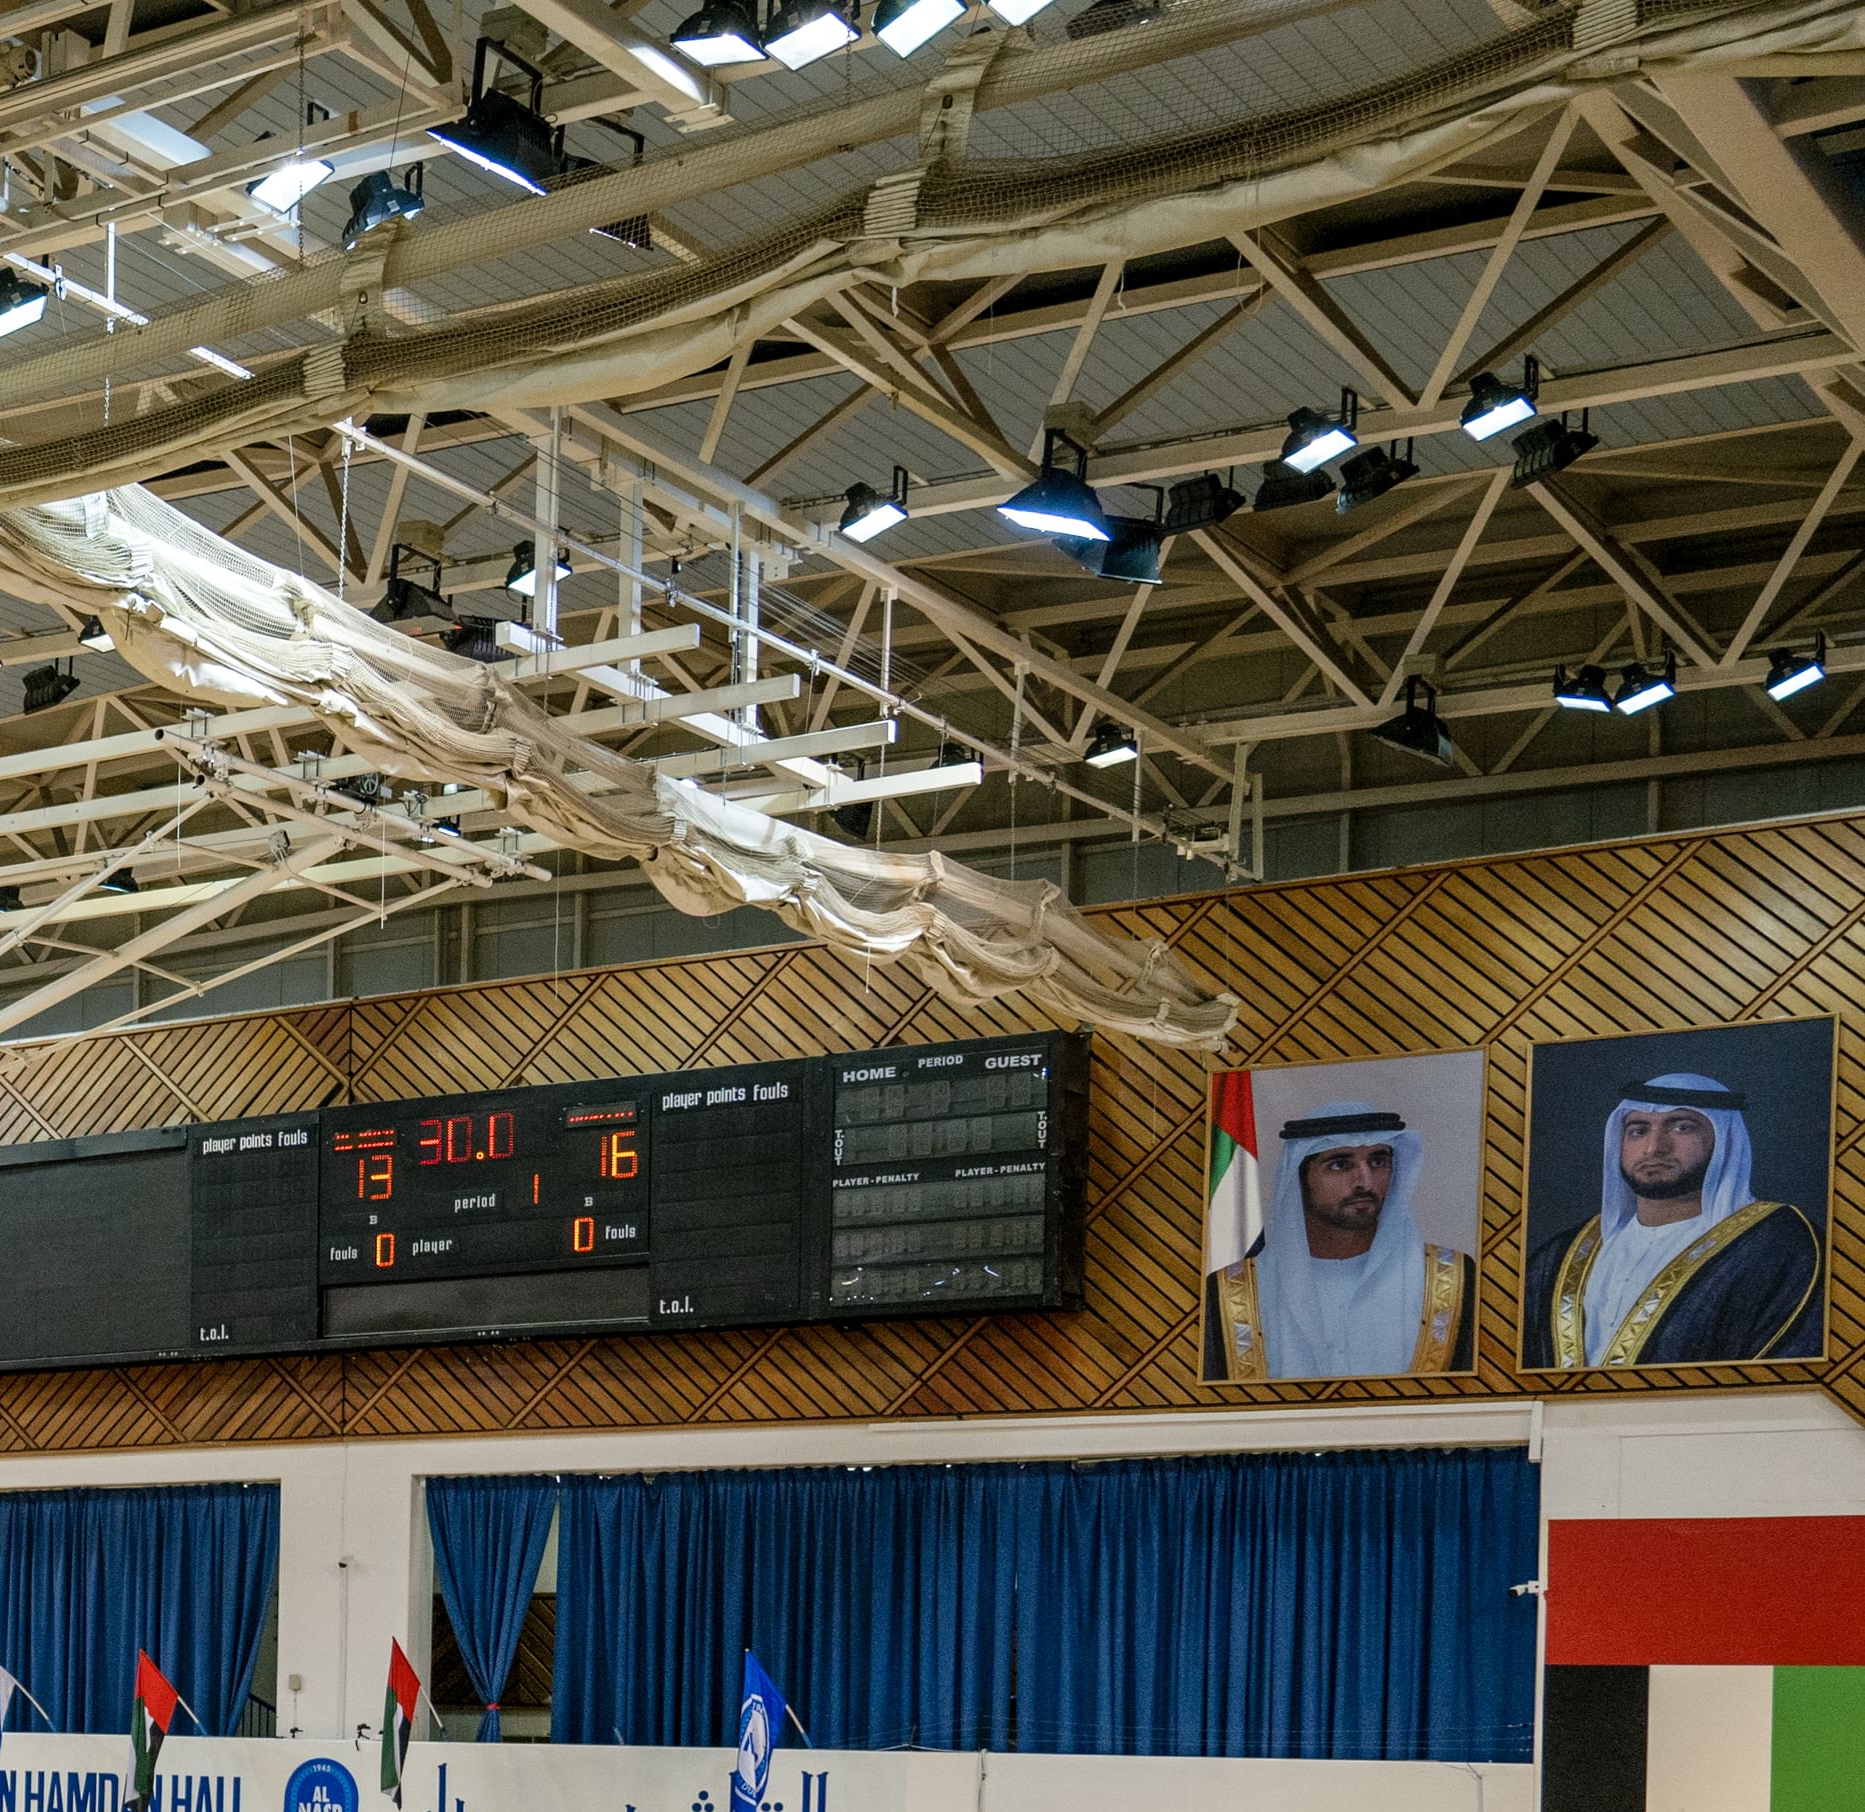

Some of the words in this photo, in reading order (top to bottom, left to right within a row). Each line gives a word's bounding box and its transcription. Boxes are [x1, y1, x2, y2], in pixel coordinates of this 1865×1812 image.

[917, 1054, 964, 1069] PERIOD
[984, 1054, 1042, 1070] GUEST
[842, 1066, 897, 1083] HOME
[662, 1090, 702, 1111] player
[706, 1086, 746, 1106] points
[752, 1082, 789, 1101] fouls
[202, 1136, 238, 1155] player
[239, 1132, 272, 1152] points
[277, 1128, 308, 1147] fouls
[418, 1111, 515, 1166] 30.0
[600, 1130, 638, 1179] 16
[358, 1154, 393, 1201] 13
[454, 1193, 496, 1213] period
[573, 1216, 595, 1253] 0
[604, 1223, 637, 1241] fouls
[330, 1245, 358, 1261] fouls
[375, 1232, 395, 1268] 0
[412, 1238, 453, 1256] player
[312, 1764, 331, 1773] 1945
[312, 1786, 330, 1803] AL
